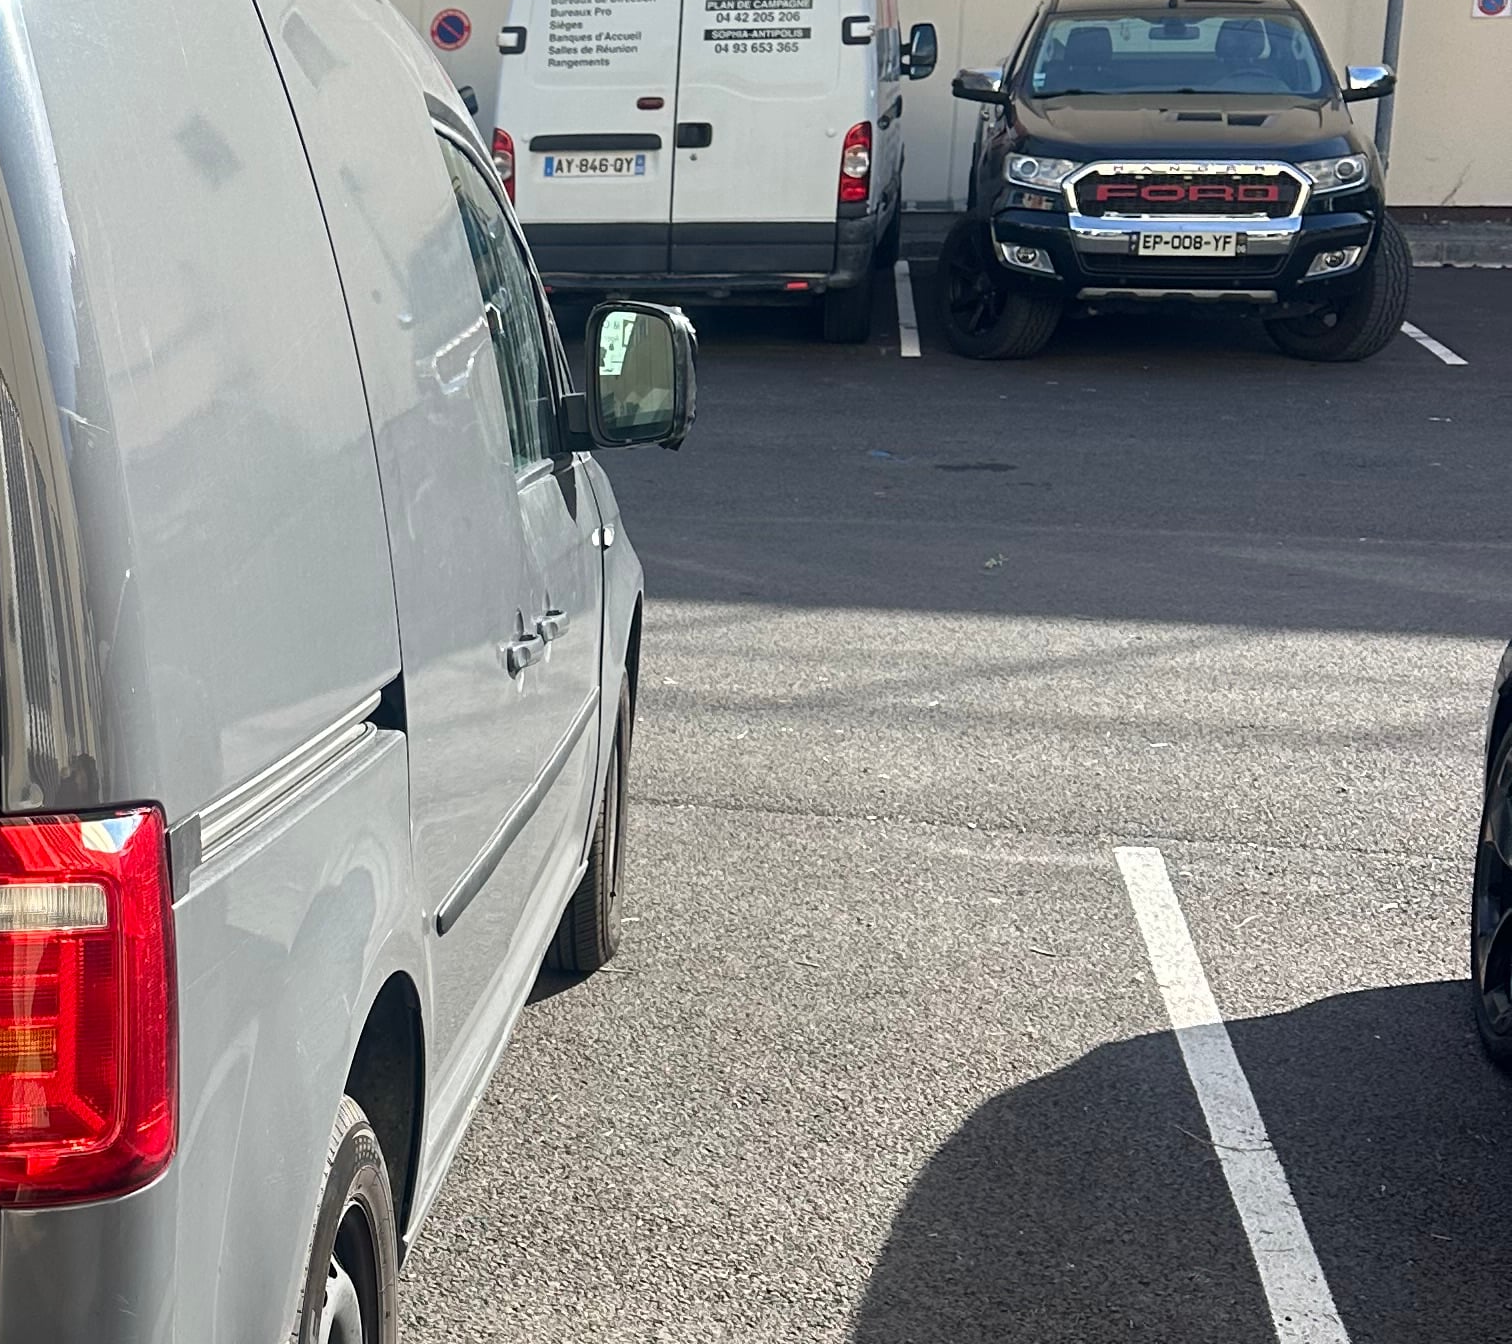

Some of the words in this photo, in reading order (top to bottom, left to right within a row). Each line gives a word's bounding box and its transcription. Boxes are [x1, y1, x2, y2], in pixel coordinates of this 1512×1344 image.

[707, 1, 734, 9] PLAN
[736, 0, 751, 9] DE
[753, 0, 810, 9] CAMPAGNE
[550, 8, 592, 17] Bureaux
[594, 7, 612, 17] Pro
[716, 12, 730, 23] 04
[734, 12, 749, 23] 42
[752, 12, 775, 23] 205
[778, 11, 801, 22] 206
[549, 33, 592, 43] Banques
[548, 45, 578, 55] Salles
[580, 45, 593, 54] de
[595, 44, 638, 54] Réunion
[714, 43, 729, 54] 04
[732, 42, 748, 53] 93
[751, 42, 773, 53] 653
[776, 42, 799, 53] 365
[548, 58, 610, 69] Rangements
[1096, 185, 1279, 201] FORD
[1142, 235, 1232, 251] EP-008-YF
